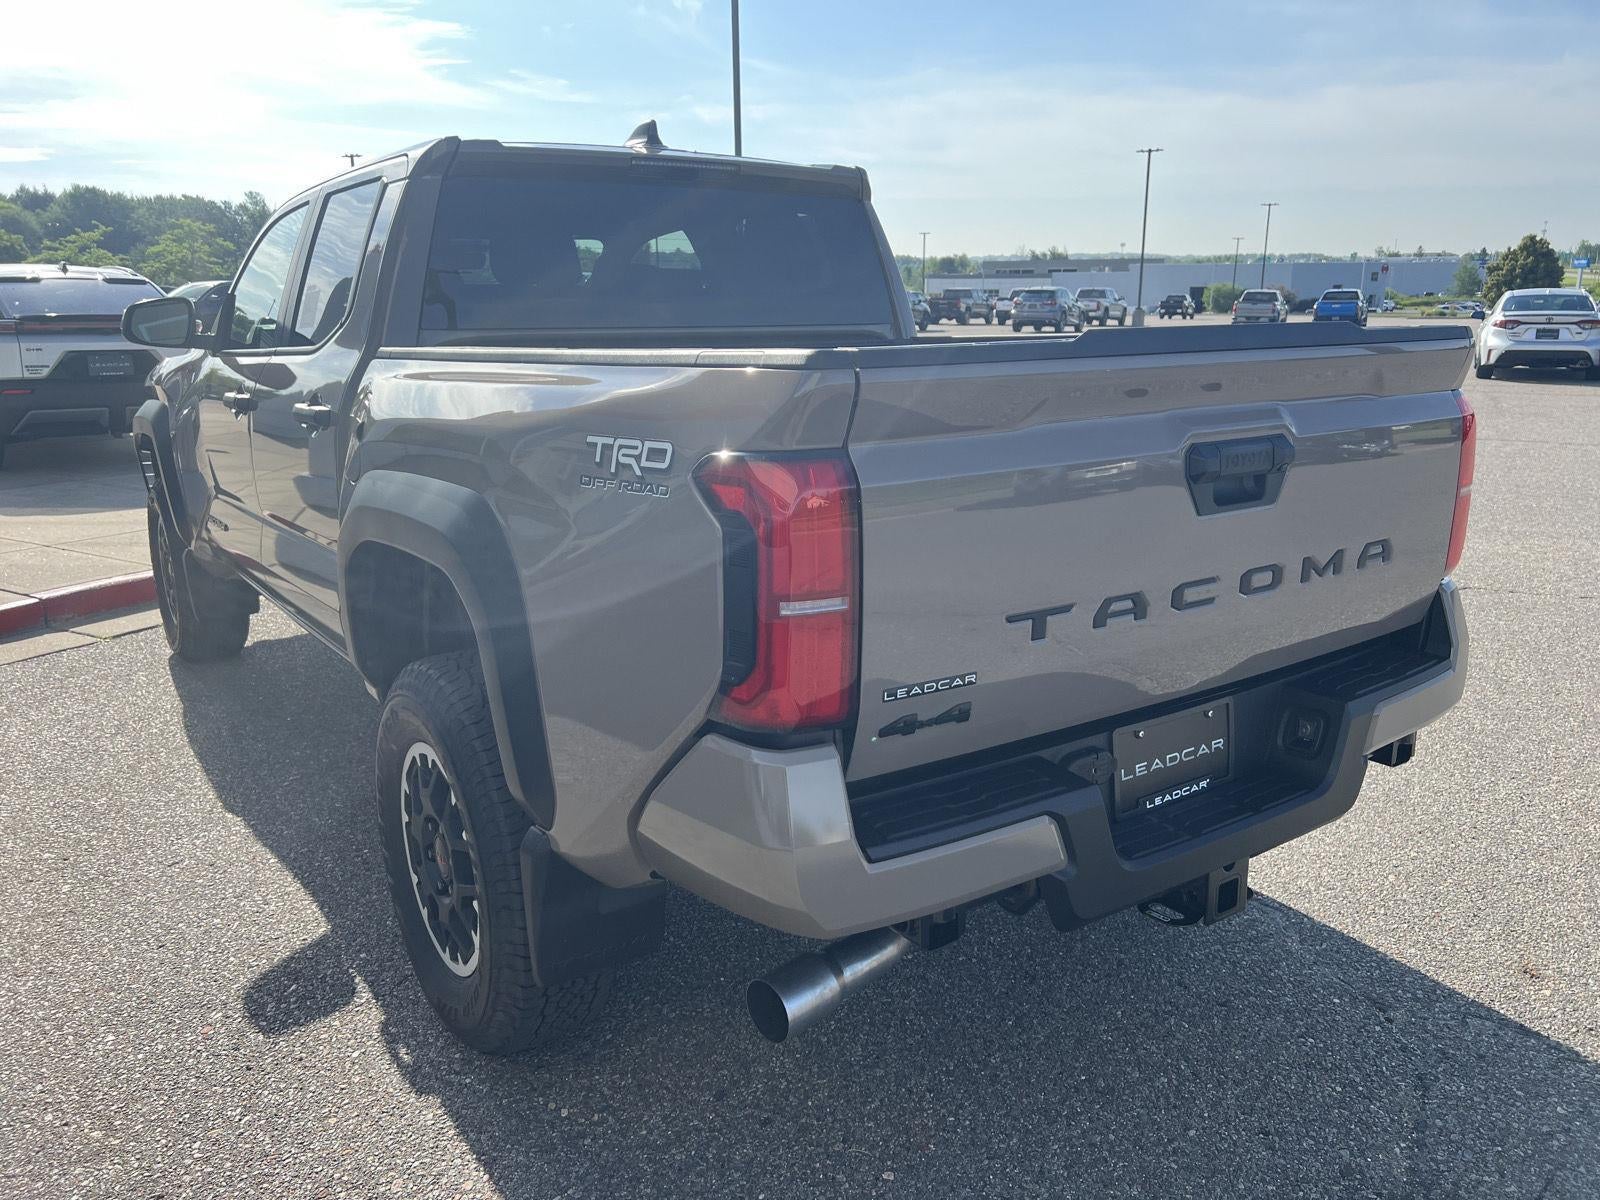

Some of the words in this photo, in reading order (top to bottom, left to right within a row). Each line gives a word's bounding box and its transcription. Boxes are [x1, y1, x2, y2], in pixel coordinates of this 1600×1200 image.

[586, 435, 673, 477] TRD
[579, 475, 617, 491] OFF
[618, 480, 671, 499] ROAD
[1005, 537, 1394, 642] TACOMA
[884, 674, 977, 701] LEADCAR
[1121, 738, 1224, 781] LEADCAR
